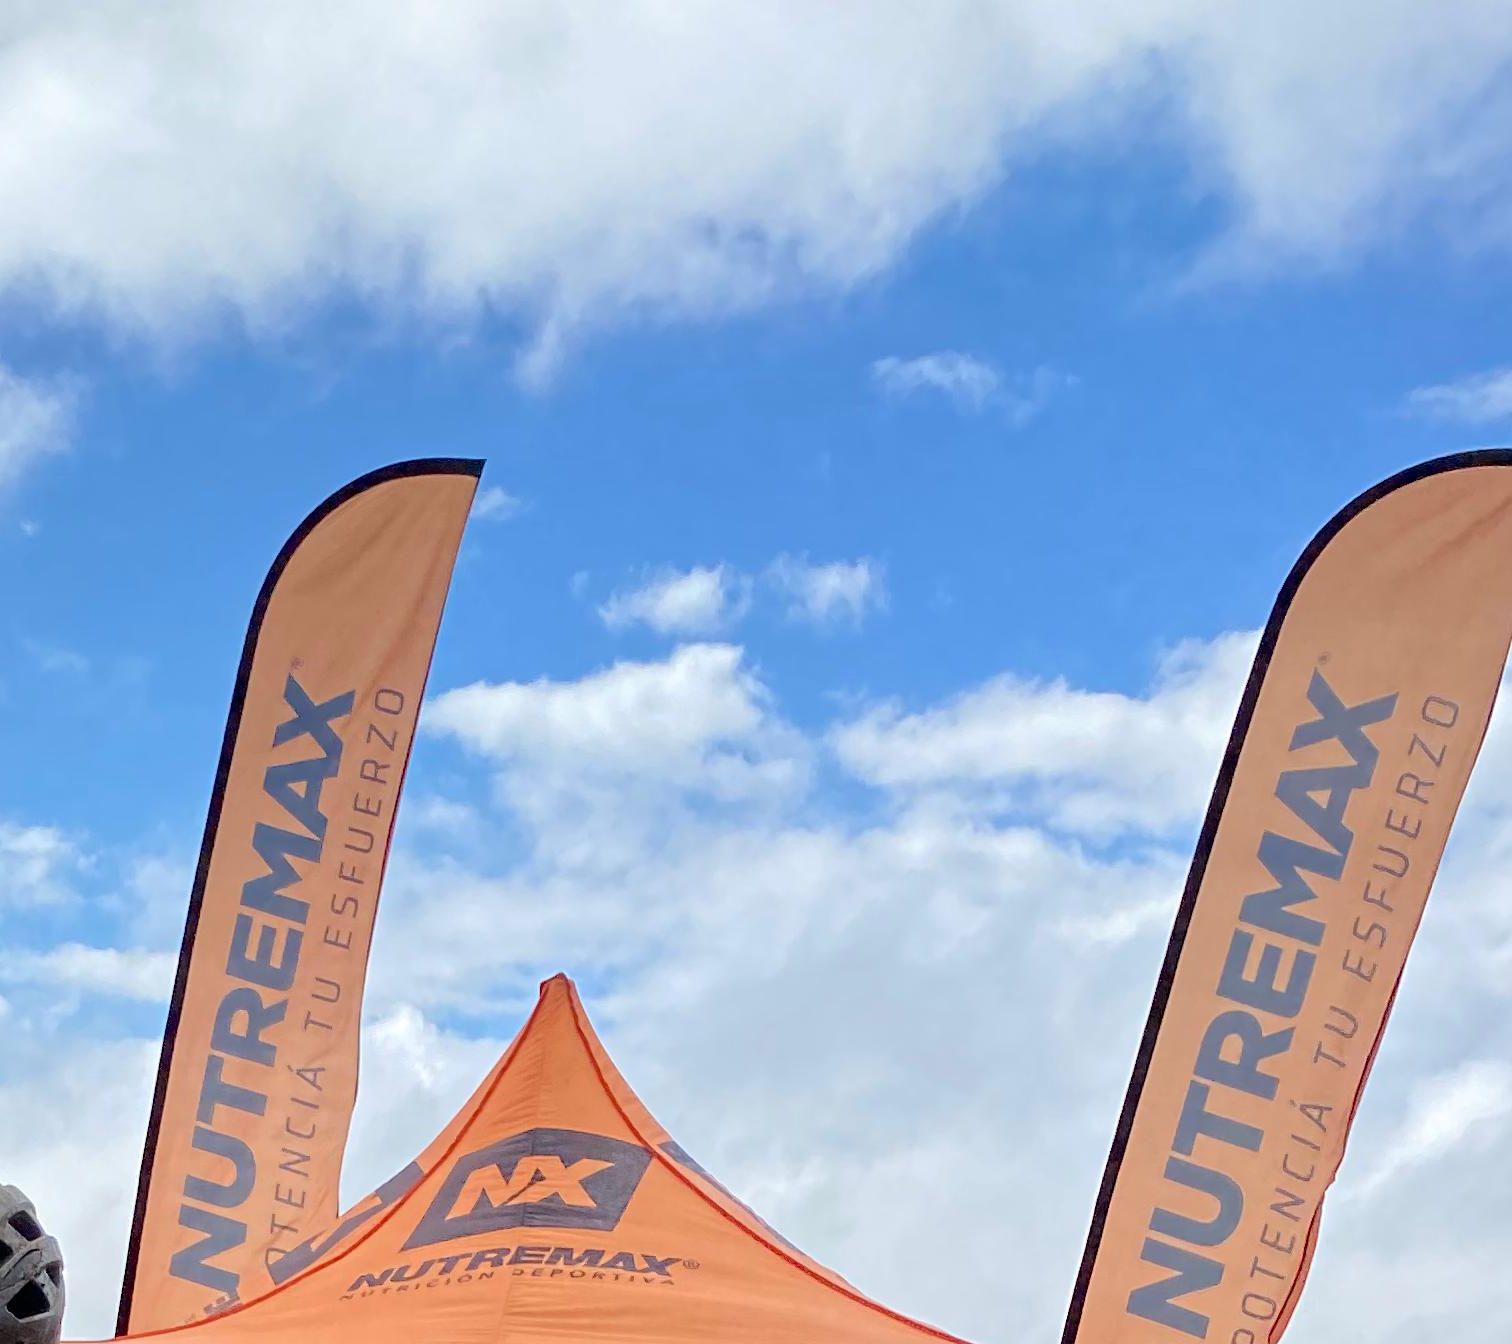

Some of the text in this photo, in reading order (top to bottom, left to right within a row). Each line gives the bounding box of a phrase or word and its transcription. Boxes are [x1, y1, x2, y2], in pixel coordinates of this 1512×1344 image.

[169, 672, 356, 1292] NUTREMAX
[266, 687, 405, 1285] TENCIÁ TU ESFUERZO
[1126, 667, 1399, 1339] NUTREMAX
[1313, 1007, 1359, 1071] TU
[1343, 694, 1460, 983] ESFUERZO
[347, 1245, 682, 1291] NUTREMAX
